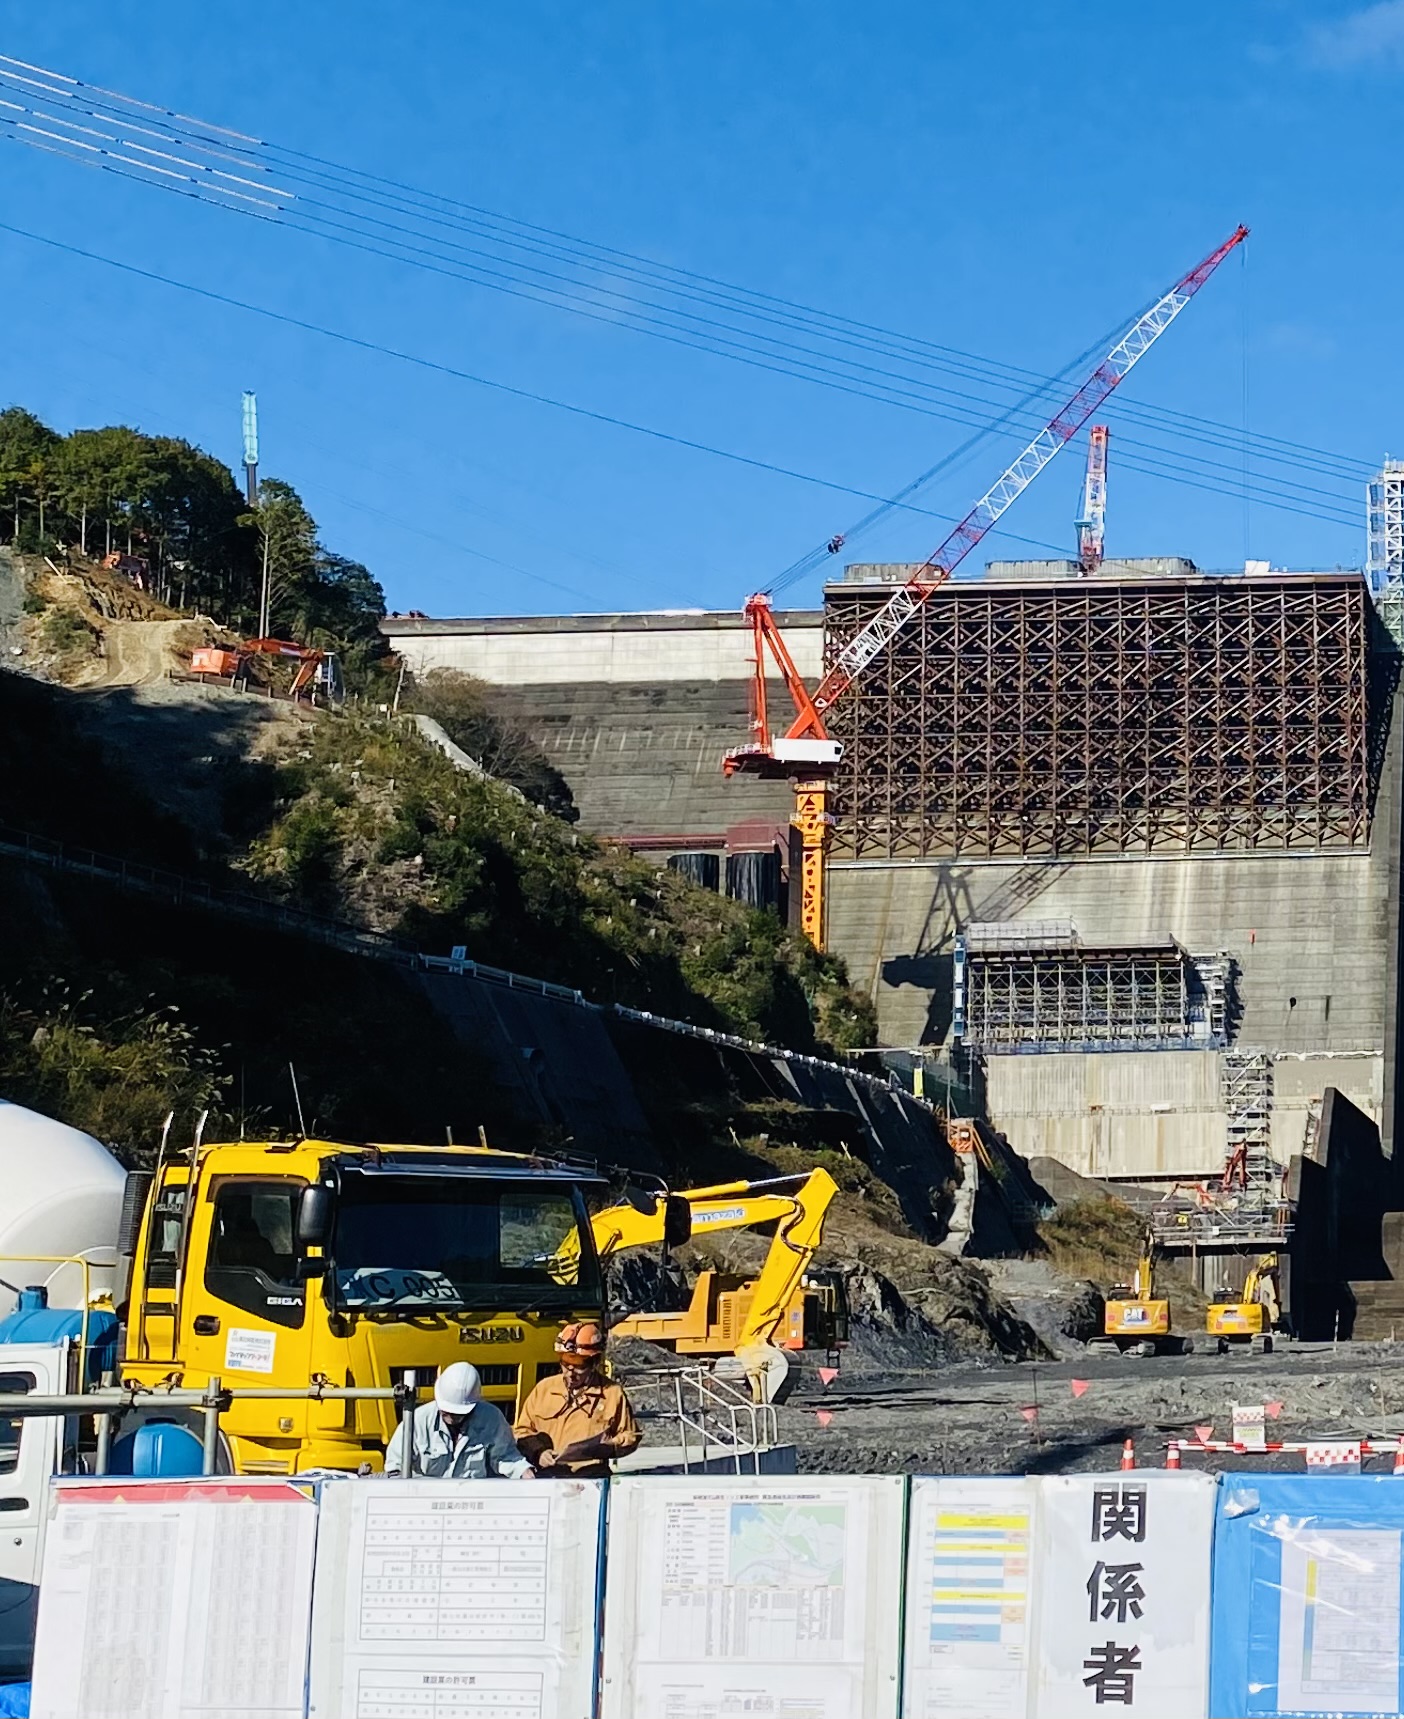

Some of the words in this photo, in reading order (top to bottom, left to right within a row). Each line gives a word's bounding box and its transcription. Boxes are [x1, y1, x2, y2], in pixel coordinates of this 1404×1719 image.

[691, 1209, 744, 1221] amazaki
[266, 1296, 303, 1306] GIGA
[1124, 1308, 1144, 1321] CAT
[458, 1326, 525, 1345] ISUZU
[1083, 1482, 1147, 1705] 関係者
